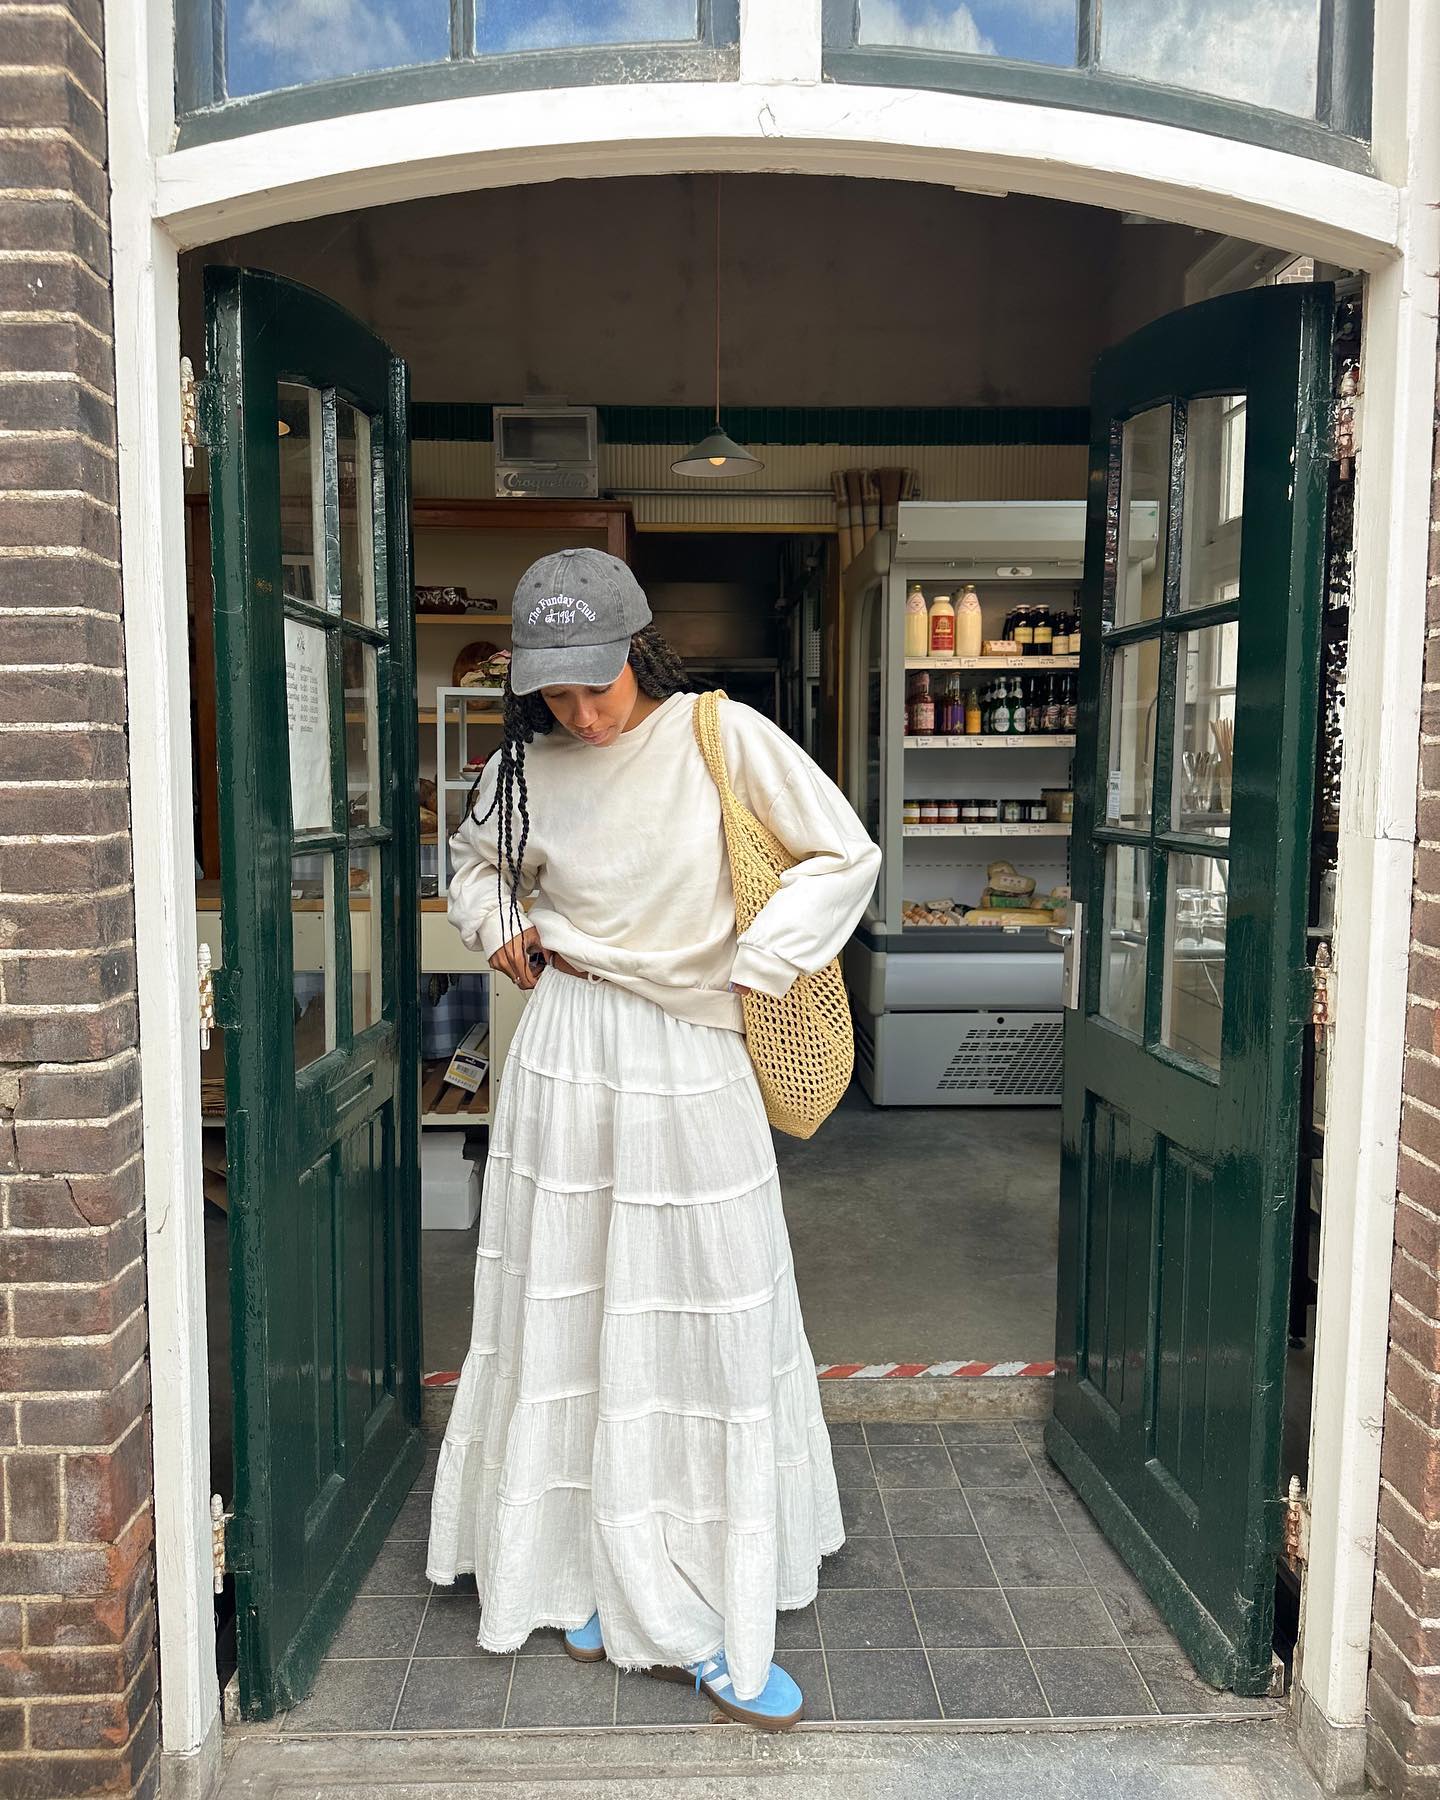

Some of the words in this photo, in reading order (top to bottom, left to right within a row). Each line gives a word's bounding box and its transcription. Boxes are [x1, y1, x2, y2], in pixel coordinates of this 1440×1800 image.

[528, 606, 542, 626] The
[538, 593, 575, 610] Funday
[575, 599, 597, 622] Club
